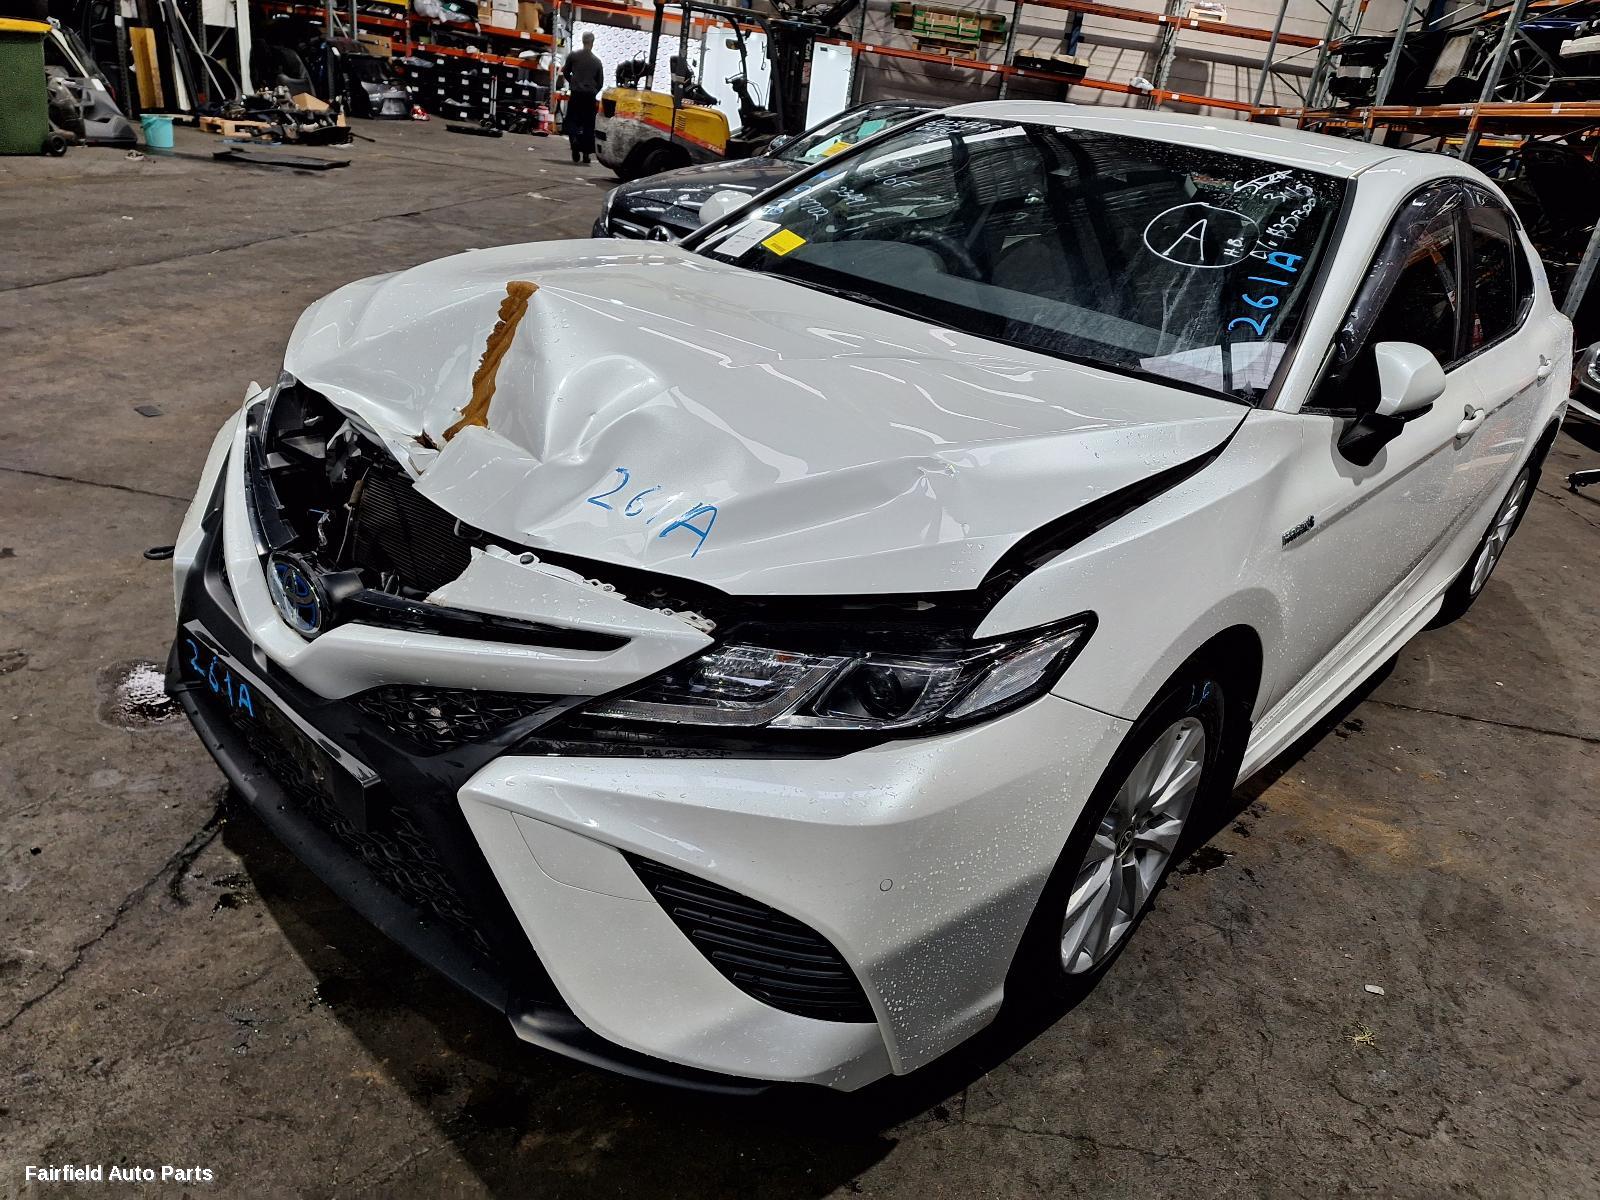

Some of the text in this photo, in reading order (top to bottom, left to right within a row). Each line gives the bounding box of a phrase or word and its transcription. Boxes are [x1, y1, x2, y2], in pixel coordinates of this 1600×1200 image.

[1161, 218, 1208, 262] A
[1227, 250, 1304, 336] 261A
[586, 466, 718, 559] 261A
[185, 638, 256, 719] 261A
